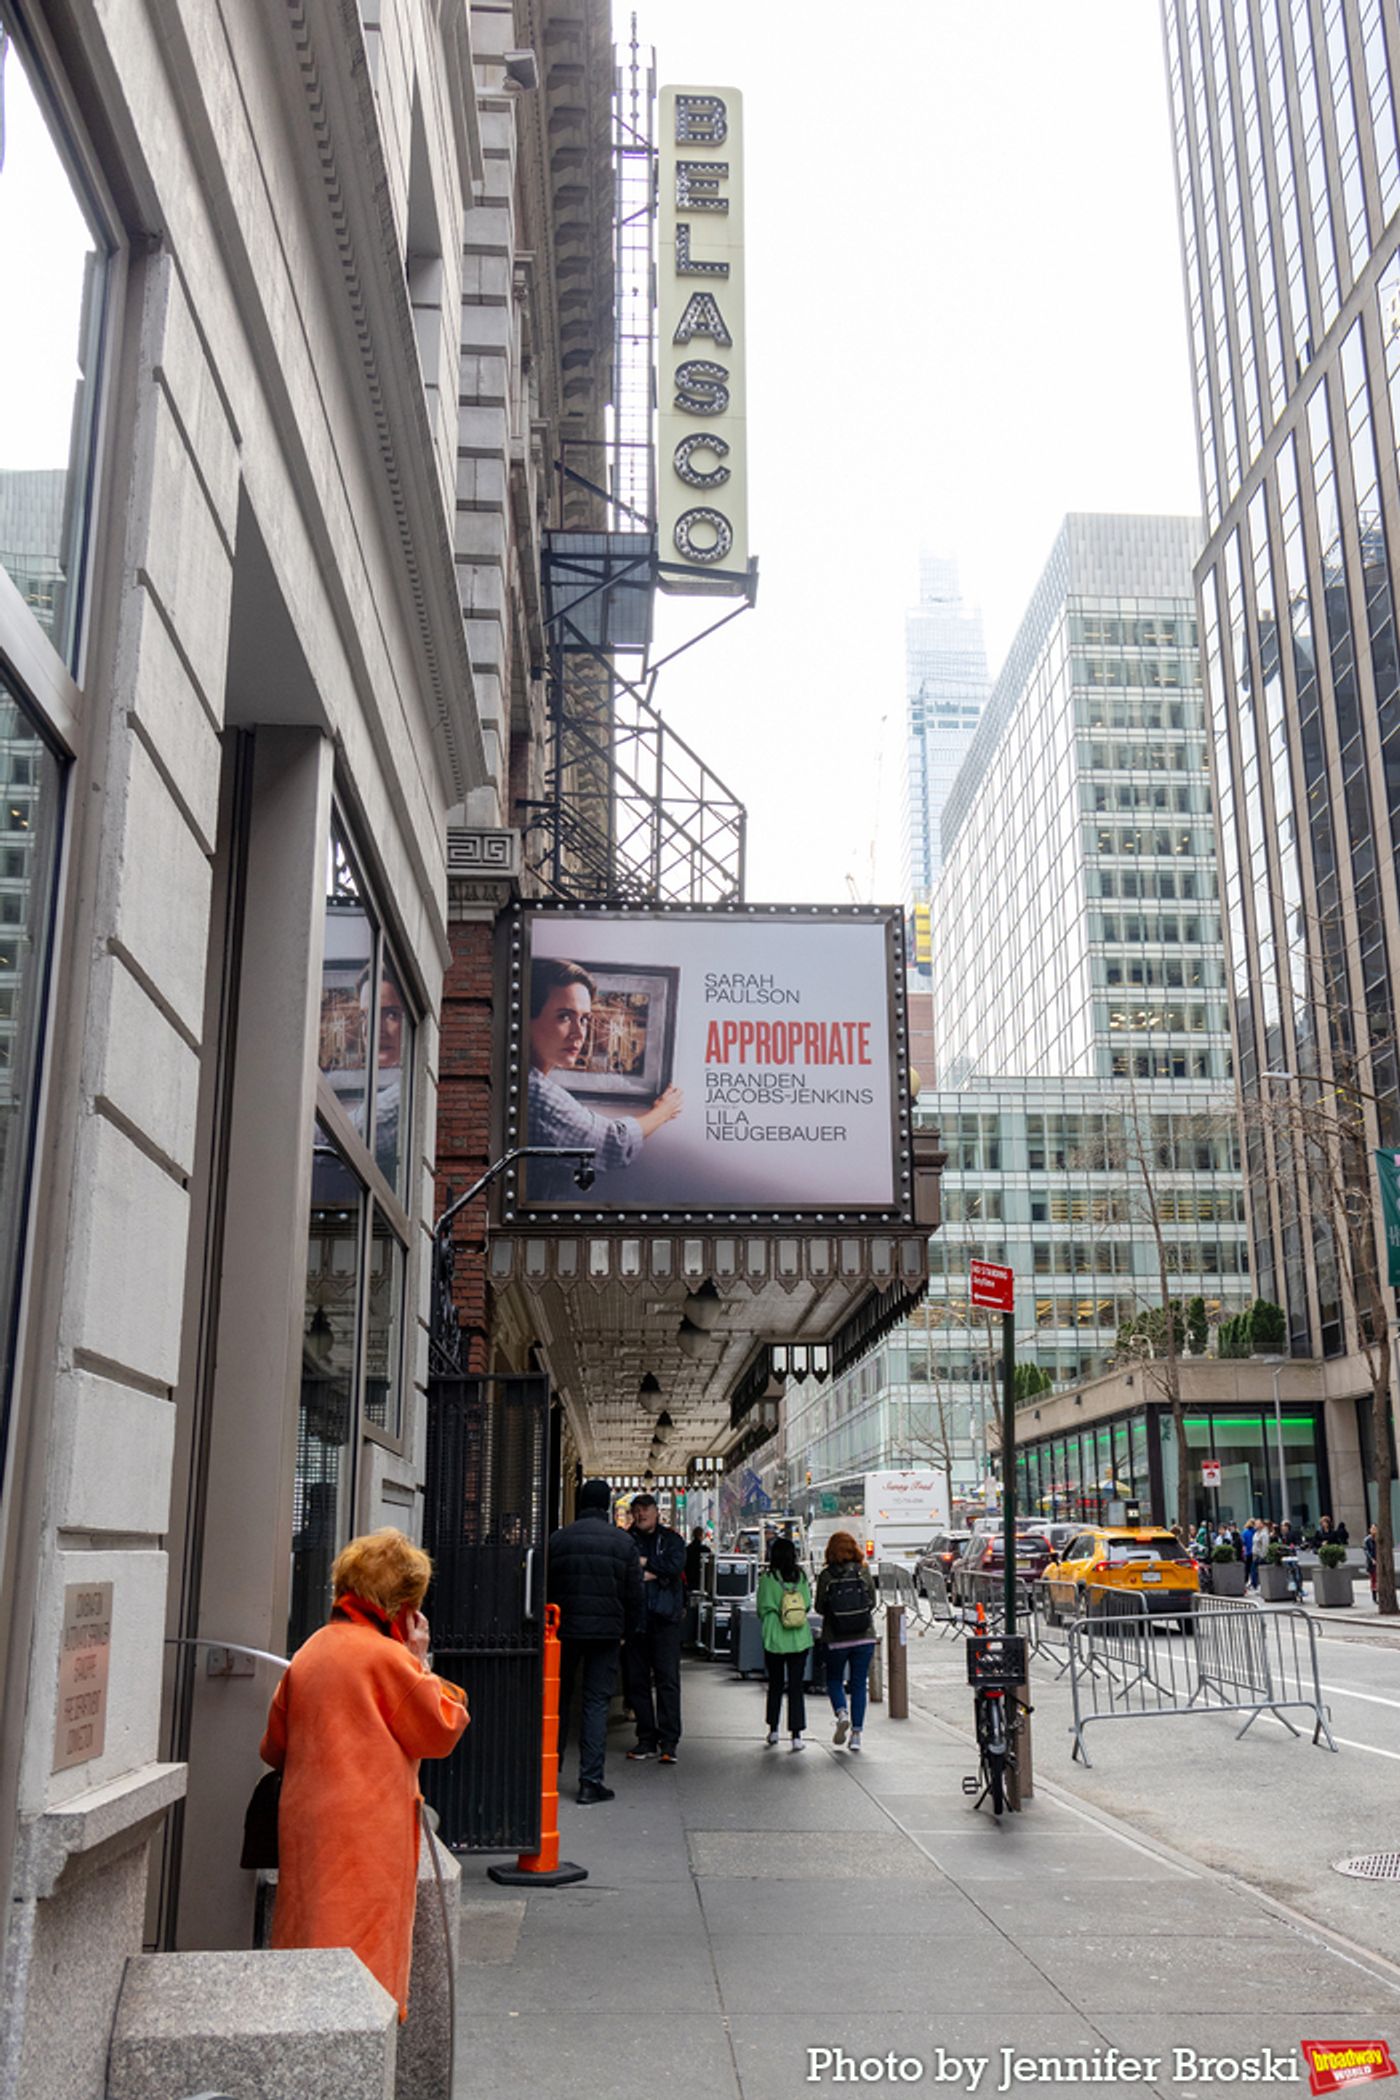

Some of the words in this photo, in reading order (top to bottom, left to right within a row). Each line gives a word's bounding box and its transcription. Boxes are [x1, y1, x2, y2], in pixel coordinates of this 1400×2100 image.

[672, 94, 733, 565] BELASCO
[705, 973, 773, 988] SARAH
[705, 989, 800, 1004] PAULSON
[705, 1020, 872, 1065] APPROPRIATE
[705, 1072, 805, 1088] BRANDEN
[705, 1088, 873, 1104] JACOBS-JENKINS
[706, 1110, 749, 1125] LILA
[706, 1126, 847, 1141] NEUGEBAUER
